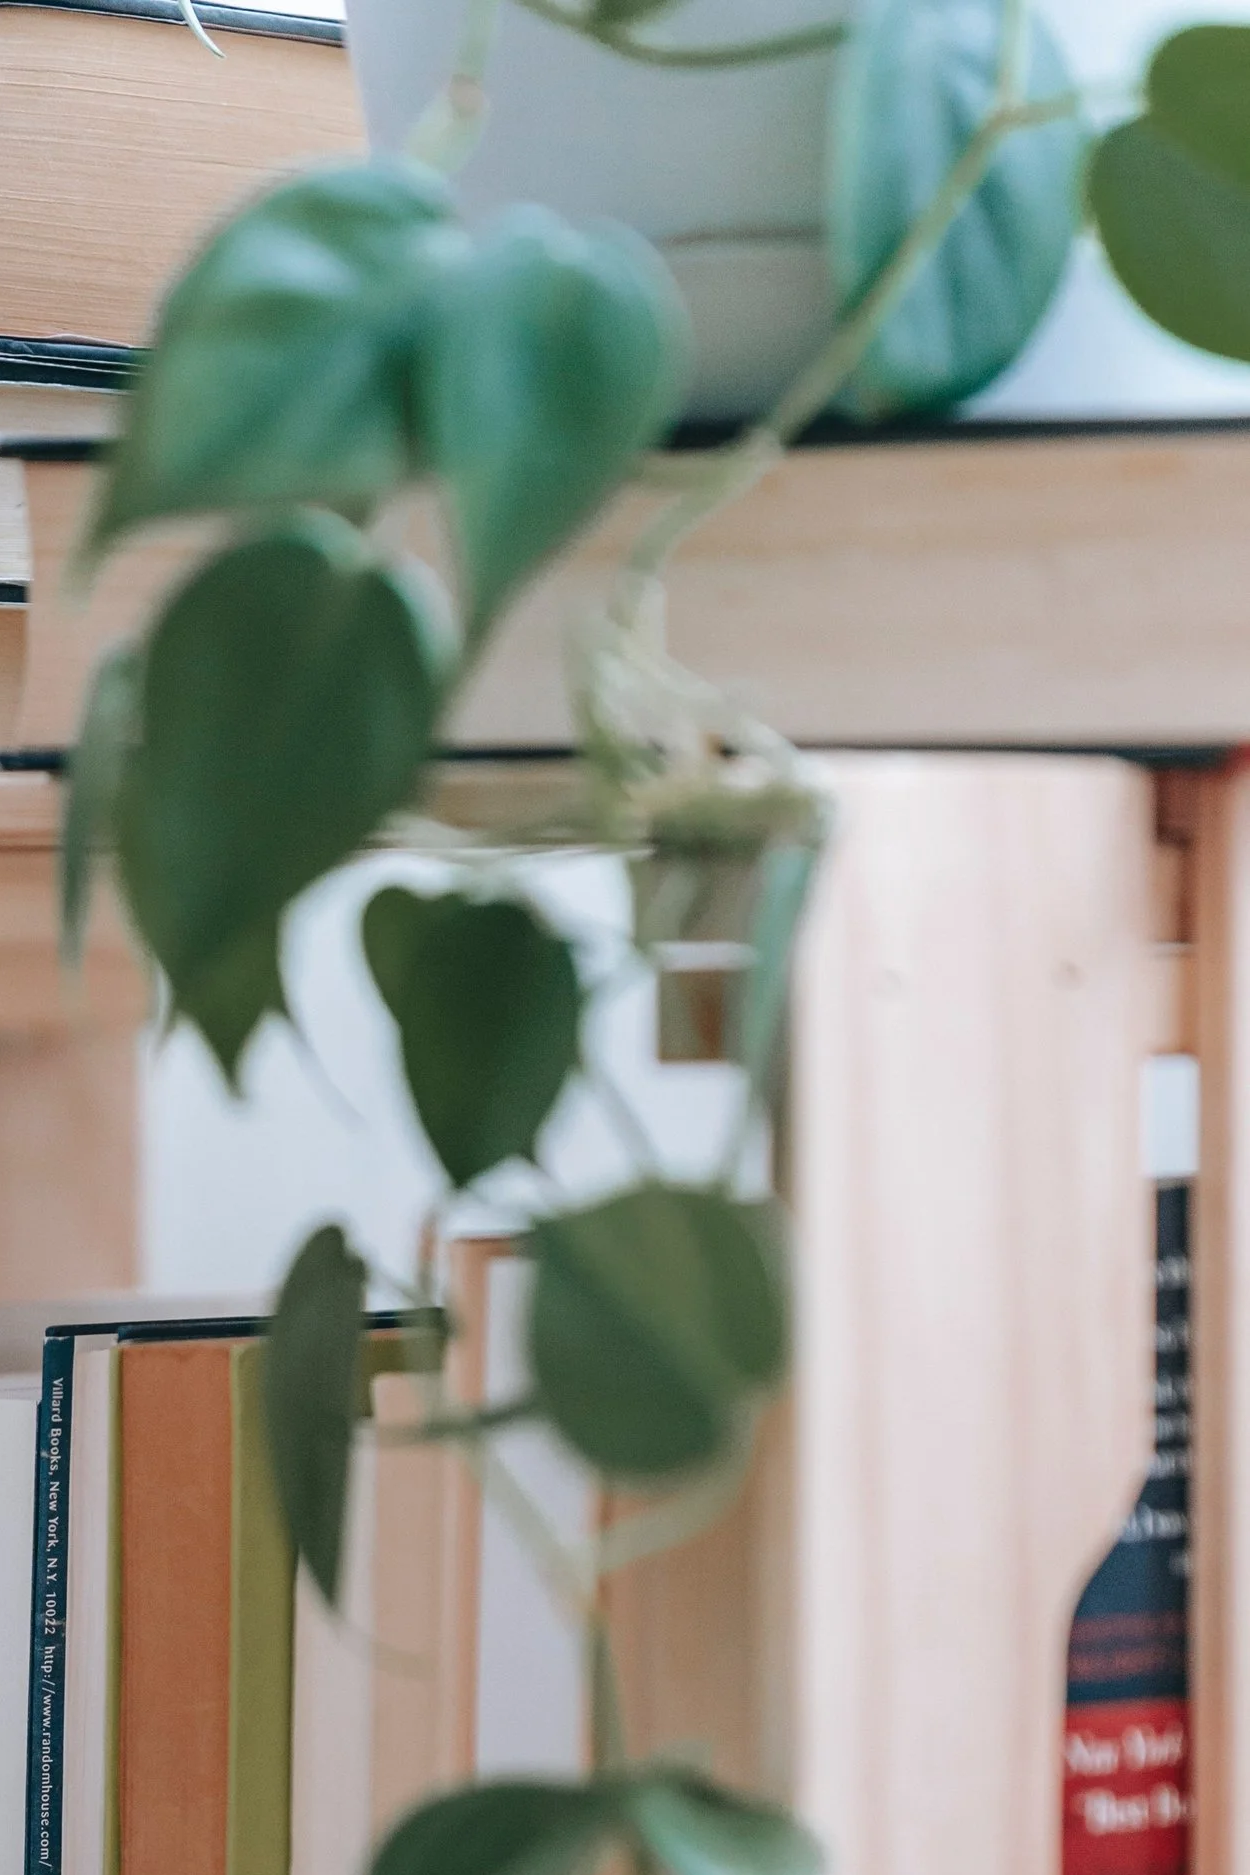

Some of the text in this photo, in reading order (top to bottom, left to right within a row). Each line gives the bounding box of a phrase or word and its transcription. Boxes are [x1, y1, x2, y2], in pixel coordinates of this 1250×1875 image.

[51, 1377, 64, 1422] Villard
[48, 1428, 61, 1475] Books,
[48, 1481, 60, 1511] New
[45, 1517, 60, 1551] York,
[46, 1557, 58, 1584] N.Y.
[44, 1591, 56, 1634] 10022
[38, 1645, 55, 1867] http://www.randomhouse.com/
